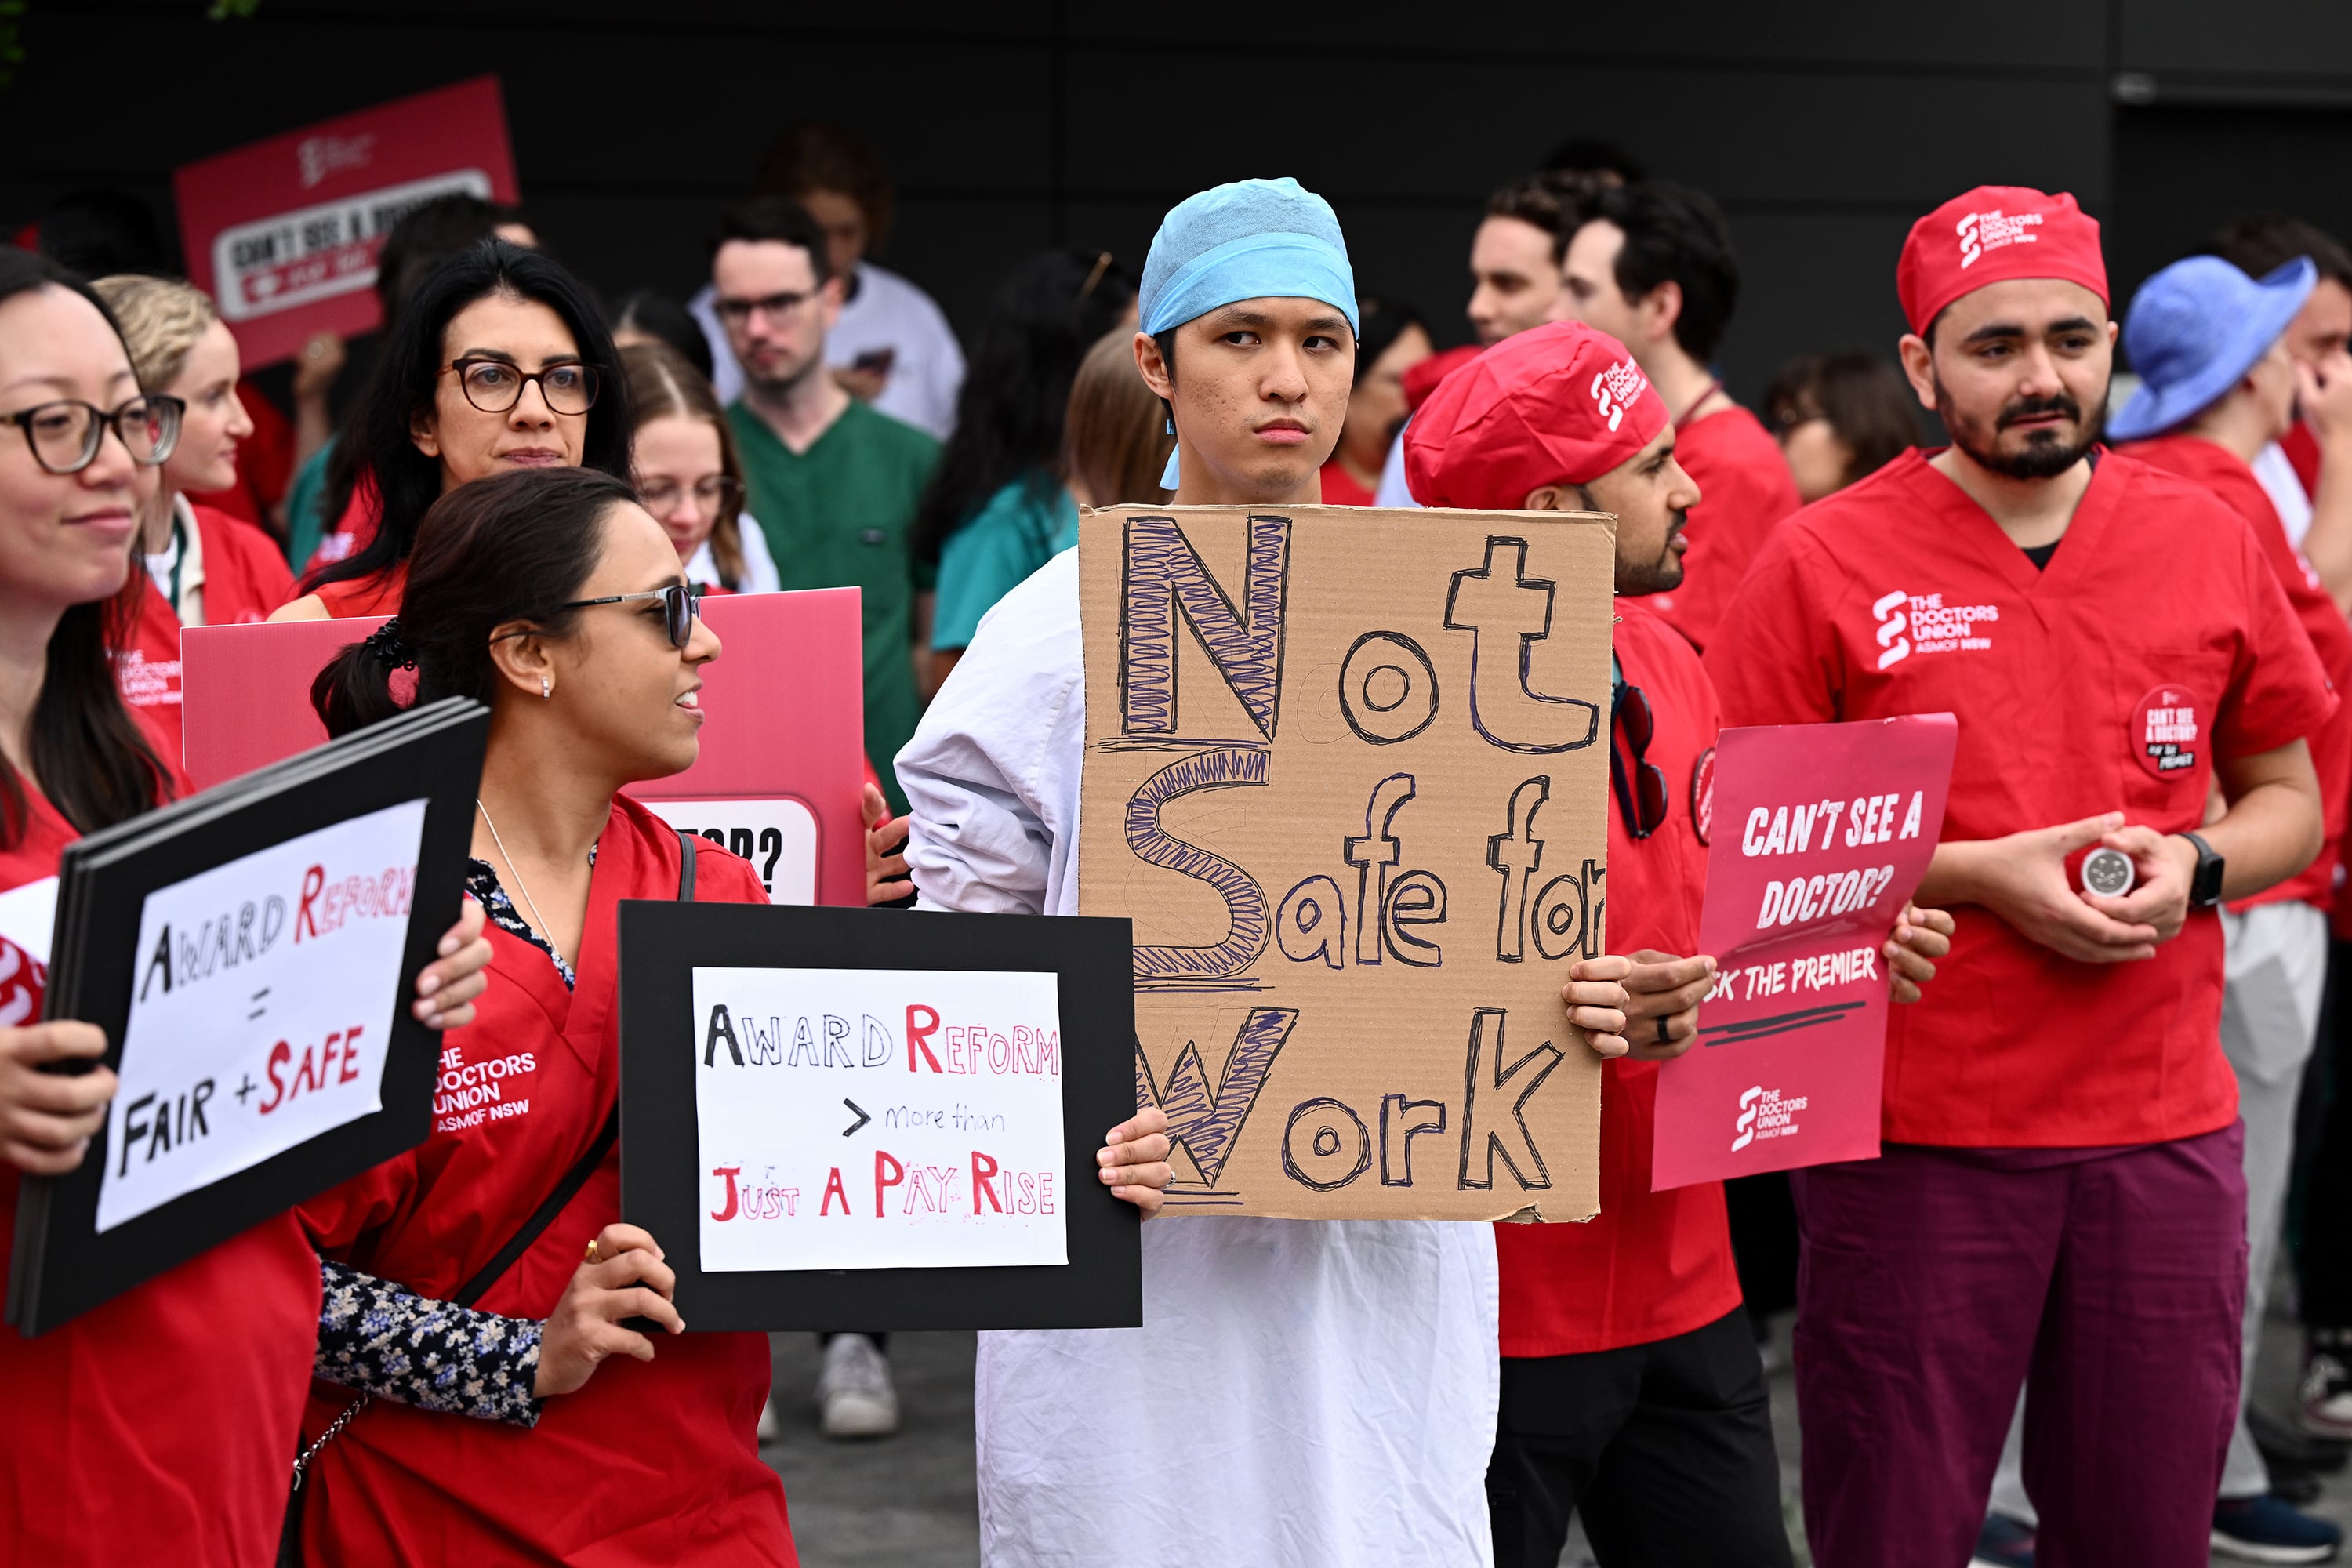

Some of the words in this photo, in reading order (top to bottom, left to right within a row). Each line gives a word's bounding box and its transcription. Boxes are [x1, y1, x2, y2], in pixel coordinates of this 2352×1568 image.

[1907, 593, 1943, 611] THE
[1910, 605, 1999, 626] DOCTORS
[1119, 514, 1599, 755] Not
[1911, 622, 1971, 641] UNION
[1915, 638, 1959, 654] ASMOF
[1742, 799, 1845, 857] CAN'T
[1846, 793, 1899, 848] SEE
[1898, 790, 1923, 840] A
[1125, 749, 1449, 978] Safe
[1487, 775, 1606, 964] for
[1756, 864, 1895, 929] DOCTOR?
[140, 895, 286, 1003] AWARD
[1745, 961, 1787, 1001] THE
[1791, 947, 1878, 993] PREMIER
[703, 1004, 893, 1068] AWARD
[906, 1004, 1058, 1076] REFORM
[118, 1076, 216, 1178] FAIR
[259, 1025, 365, 1115] SAFE
[432, 1081, 501, 1114] UNION
[437, 1108, 487, 1133] ASMOF
[489, 1099, 529, 1120] NSW
[953, 1103, 1005, 1132] than
[1134, 1007, 1565, 1192] Work
[1758, 1096, 1808, 1116] DOCTORS
[1762, 1089, 1780, 1103] THE
[1757, 1112, 1791, 1129] UNION
[710, 1166, 800, 1222] JUST
[819, 1167, 851, 1216] A
[874, 1150, 958, 1218] PAY
[971, 1150, 1054, 1216] RISE
